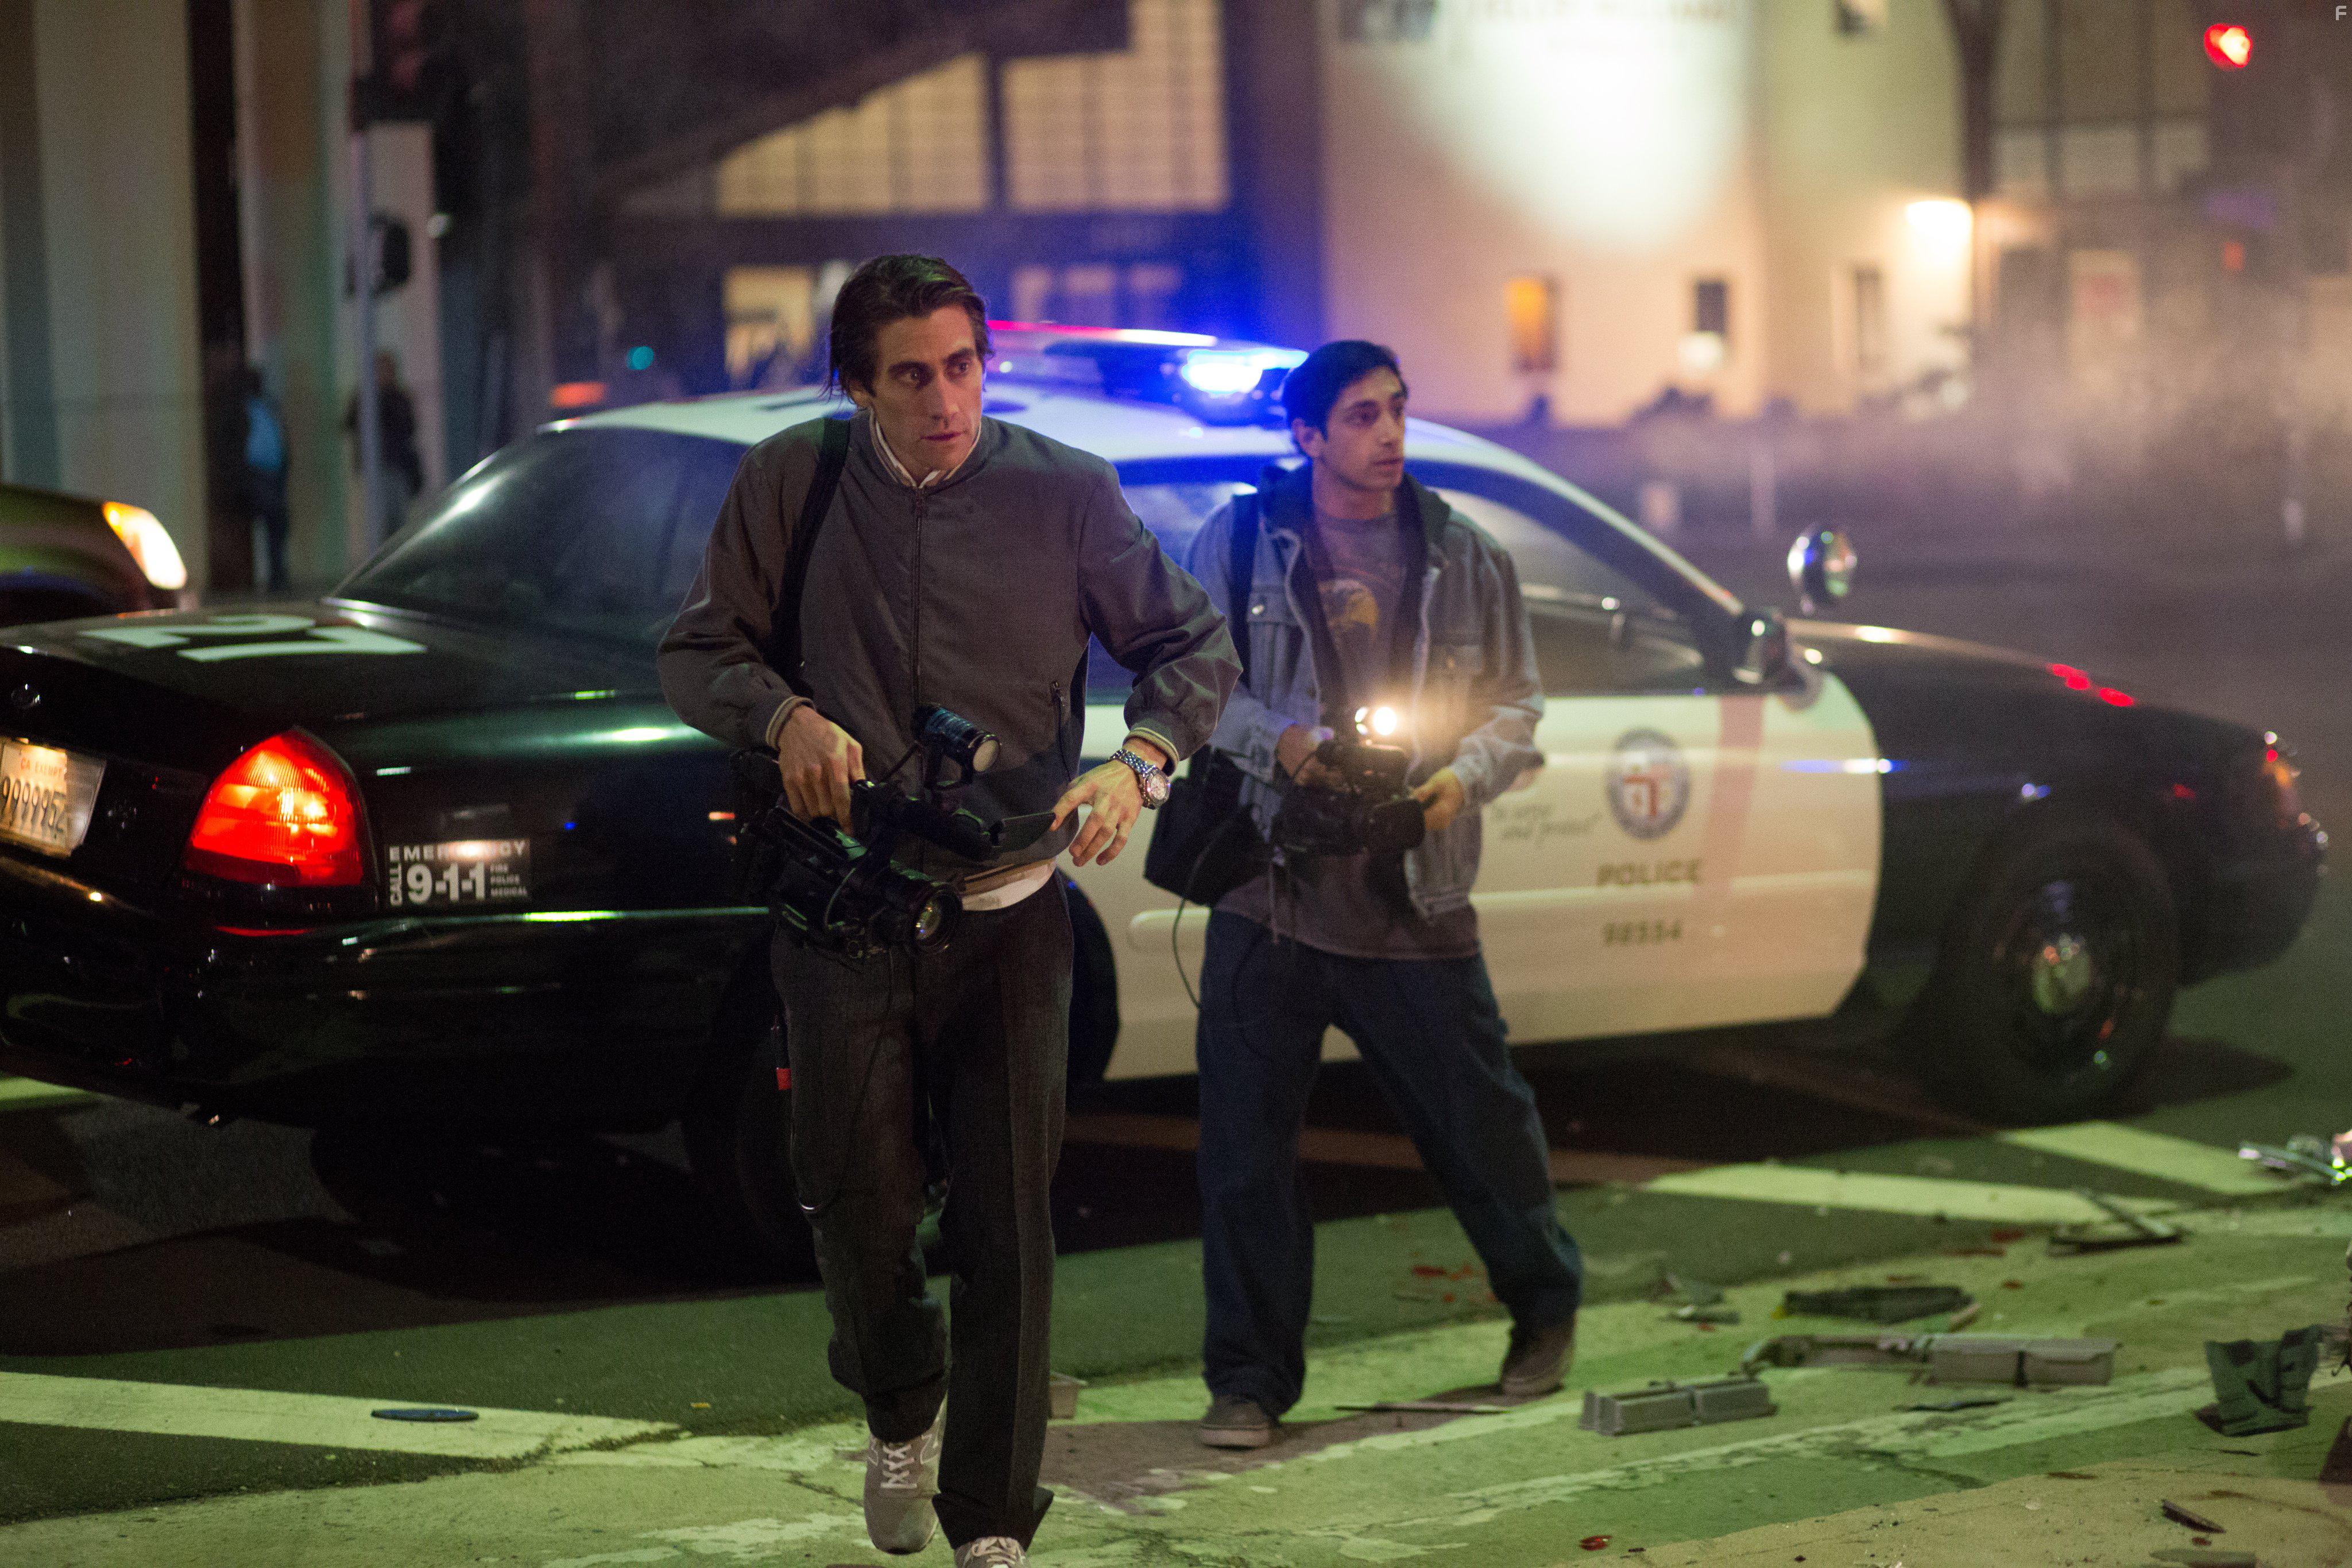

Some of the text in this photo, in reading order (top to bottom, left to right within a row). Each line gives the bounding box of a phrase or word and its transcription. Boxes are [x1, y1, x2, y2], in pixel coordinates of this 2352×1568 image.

[21, 757, 63, 777] CA EXEMPT
[389, 863, 403, 907] CALL
[1597, 858, 1701, 887] POLICE
